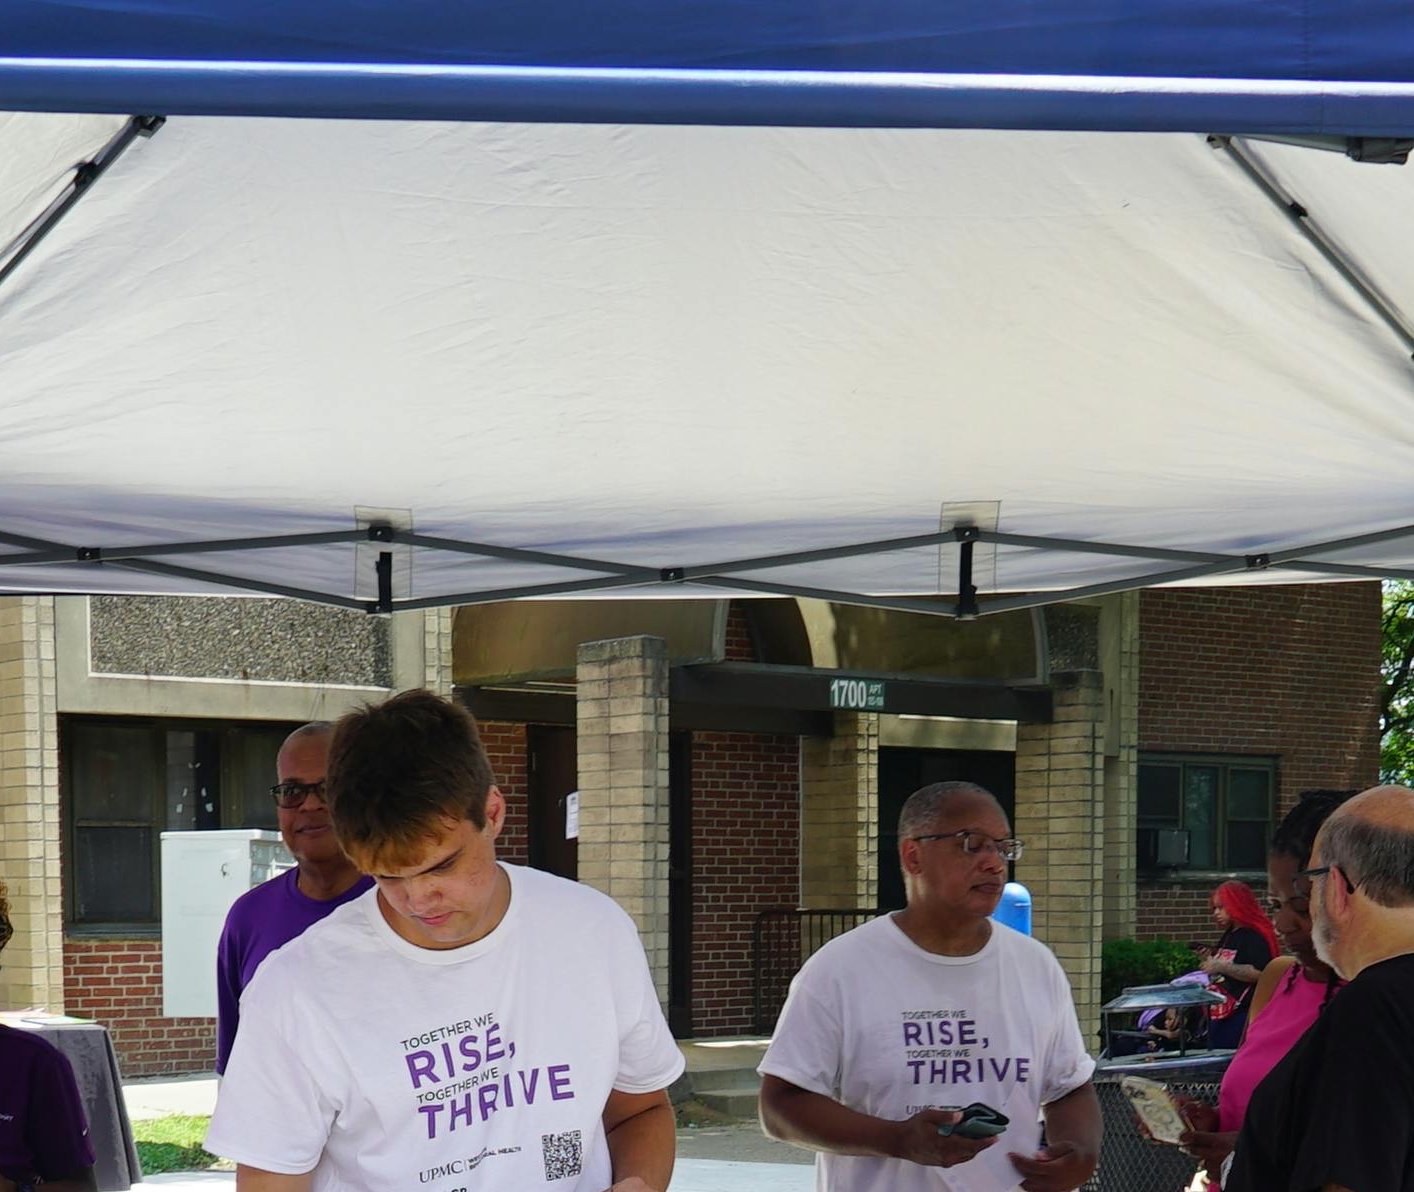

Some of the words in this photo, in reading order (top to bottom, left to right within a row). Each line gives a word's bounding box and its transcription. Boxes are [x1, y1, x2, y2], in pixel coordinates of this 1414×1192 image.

[831, 679, 867, 708] 1700
[902, 1010, 950, 1020] TOGETHER
[951, 1009, 967, 1020] WE
[400, 1020, 473, 1051] TOGETHER
[474, 1012, 495, 1029] WE
[903, 1020, 989, 1049] RISE,
[405, 1023, 516, 1089] RISE,
[906, 1050, 953, 1059] TOGETHER
[954, 1048, 971, 1058] WE
[416, 1076, 480, 1104] TOGETHER
[480, 1067, 500, 1083] WE
[907, 1057, 1030, 1085] THRIVE
[418, 1064, 575, 1139] THRIVE
[419, 1160, 464, 1183] UPMC
